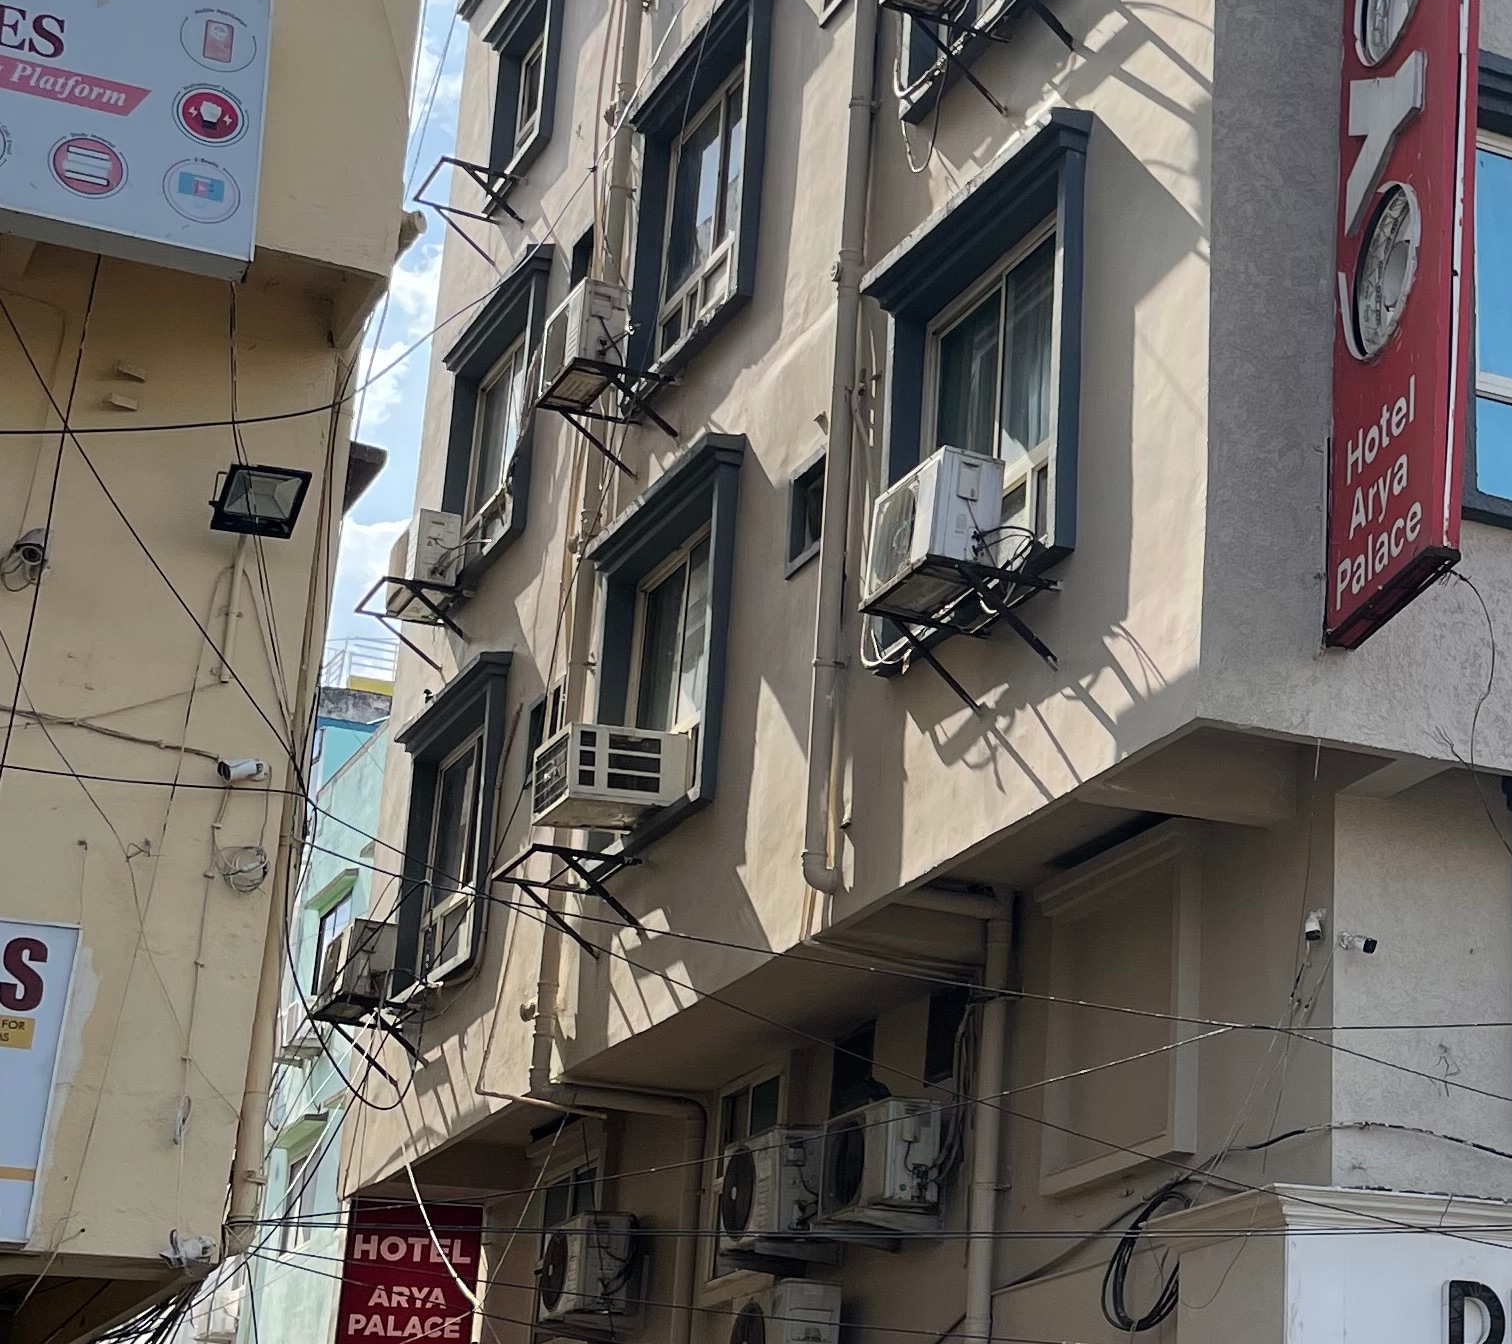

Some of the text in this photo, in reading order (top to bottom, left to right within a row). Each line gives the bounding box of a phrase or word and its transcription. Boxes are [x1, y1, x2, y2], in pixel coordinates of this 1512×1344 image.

[9, 62, 127, 106] Platform
[1346, 375, 1416, 485] Hotel
[1348, 453, 1408, 540] Arya
[1336, 501, 1422, 611] Palace
[353, 1234, 471, 1264] HOTEL
[368, 1285, 447, 1309] ARYA
[347, 1313, 461, 1339] PALACE
